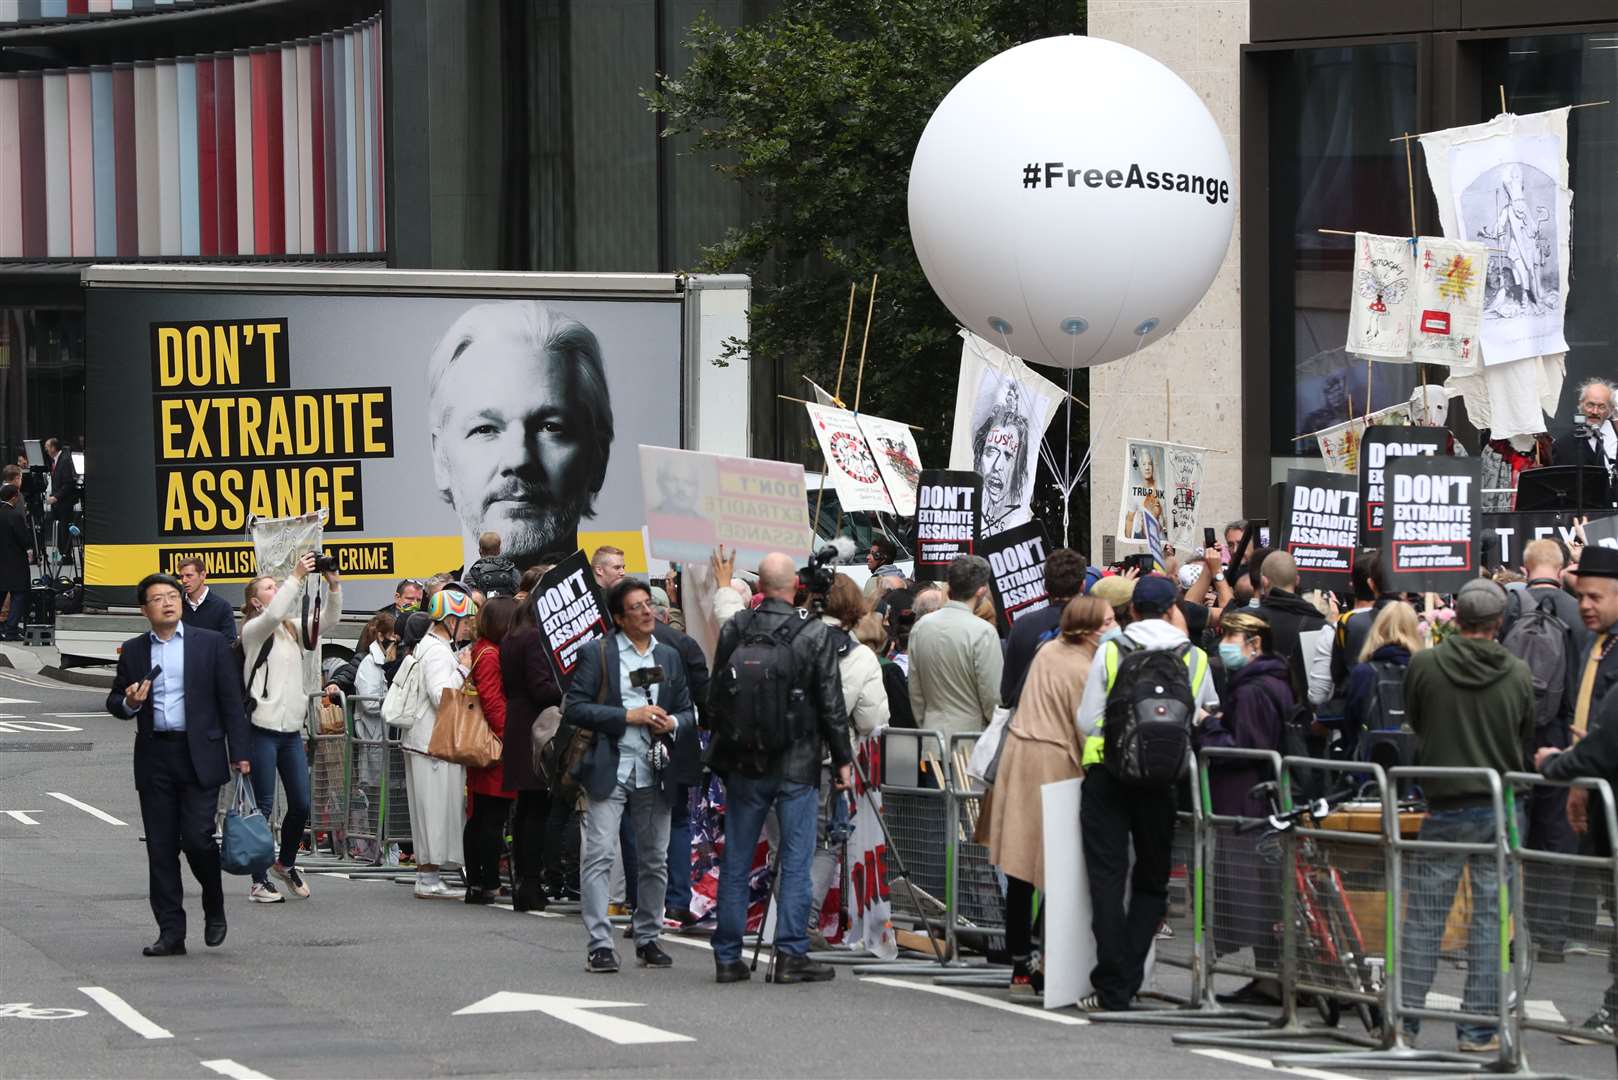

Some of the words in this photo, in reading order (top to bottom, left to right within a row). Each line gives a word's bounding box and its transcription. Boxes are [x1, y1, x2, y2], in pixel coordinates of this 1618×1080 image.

[1023, 162, 1229, 204] #FreeAssange
[158, 323, 281, 387] DON'T
[161, 392, 386, 459] EXTRADITE
[164, 466, 356, 531] ASSANGE
[920, 485, 975, 510] DON'T
[1293, 485, 1359, 516] DON'T
[1394, 474, 1472, 505] DON'T
[918, 510, 974, 524] EXTRADITE
[1291, 511, 1358, 532] EXTRADITE
[1393, 504, 1471, 522] EXTRADITE
[918, 524, 974, 540] ASSANGE
[1289, 526, 1356, 548] ASSANGE
[1393, 521, 1471, 542] ASSANGE
[339, 548, 388, 571] CRIME
[922, 543, 959, 552] Journalism
[988, 535, 1046, 578] DON'T
[1399, 545, 1452, 556] Journalism
[1410, 556, 1425, 566] not
[1435, 556, 1464, 566] crime.
[537, 567, 588, 622] DON'T
[542, 590, 596, 636] EXTRADITE
[548, 603, 602, 650] ASSANGE
